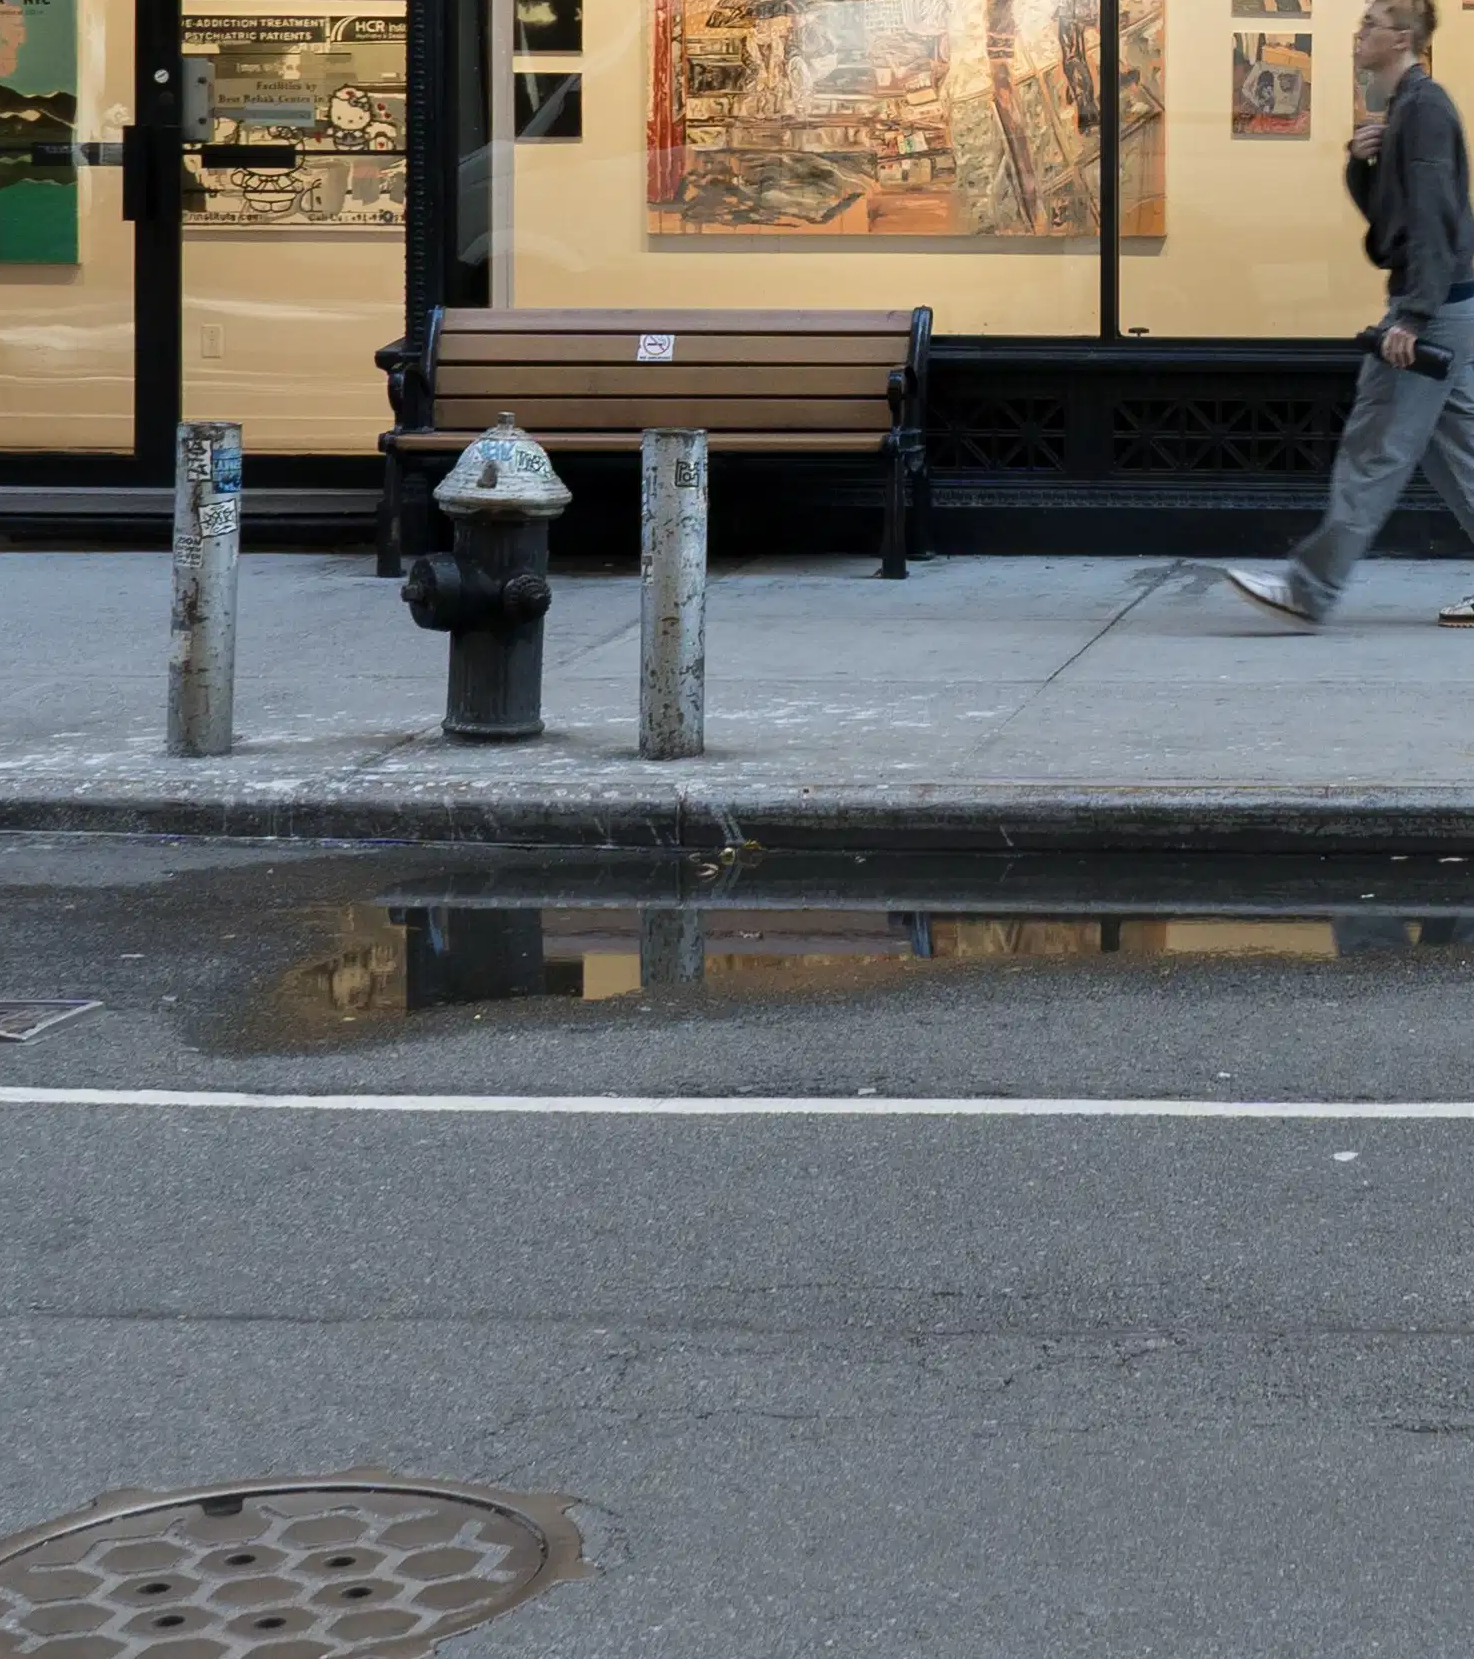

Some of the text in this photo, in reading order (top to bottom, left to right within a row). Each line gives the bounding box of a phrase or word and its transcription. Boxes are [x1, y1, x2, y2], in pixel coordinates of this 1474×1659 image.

[181, 18, 326, 29] E-ADDICTION TREATMENT
[355, 21, 385, 33] HCR
[185, 31, 312, 41] PSYCHIATRIC PATIENTS
